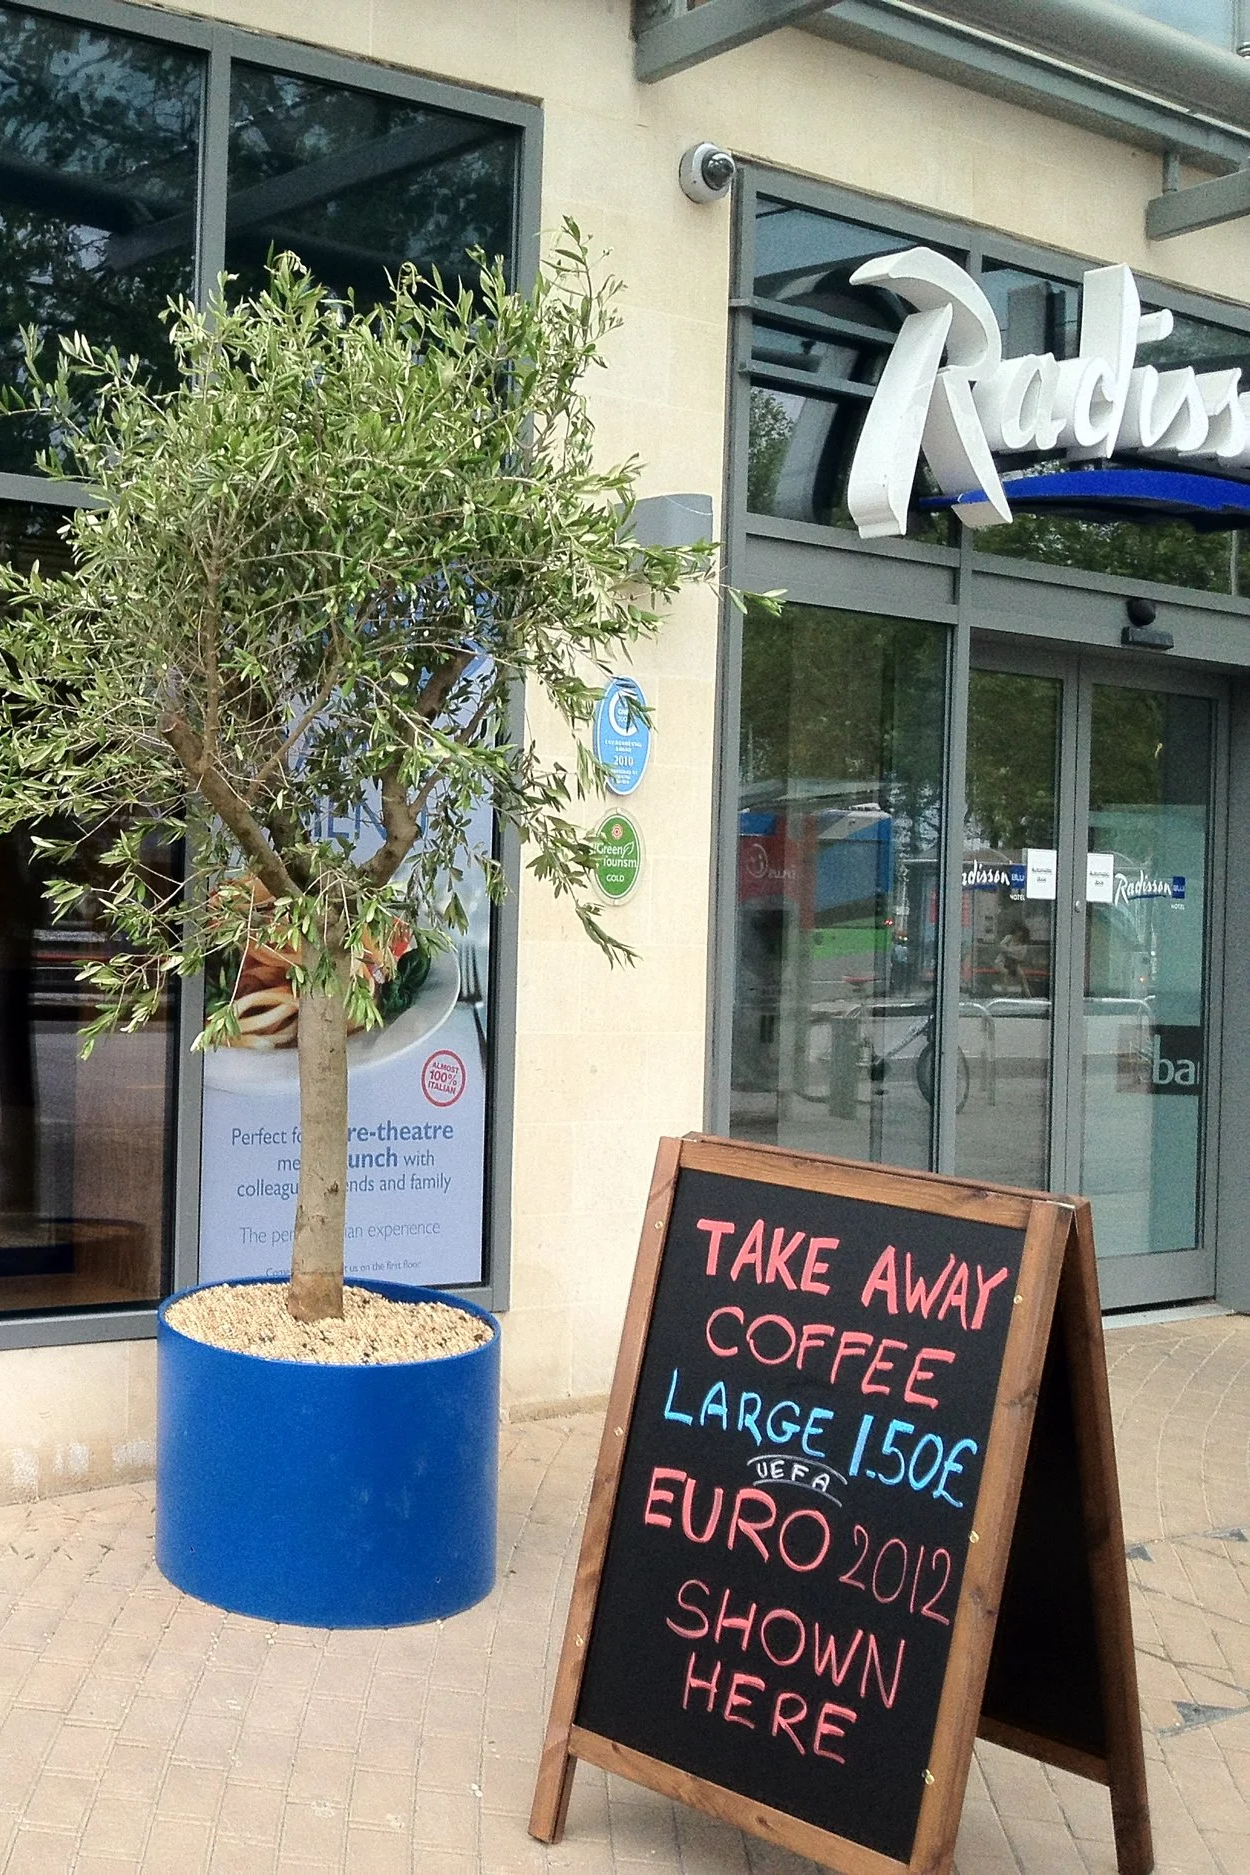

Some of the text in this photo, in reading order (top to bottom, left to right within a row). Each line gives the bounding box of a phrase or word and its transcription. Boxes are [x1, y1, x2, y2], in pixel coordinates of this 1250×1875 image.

[613, 755, 634, 767] 2010
[596, 842, 623, 855] Green
[603, 857, 637, 868] Tourism
[606, 874, 625, 882] GOLD
[1114, 869, 1172, 906] Radisson
[432, 1062, 459, 1074] ALMOST
[1152, 1033, 1200, 1085] ba
[428, 1081, 456, 1094] ITALIAN
[430, 1070, 457, 1086] 100%
[232, 1126, 287, 1146] Perfect
[404, 1149, 435, 1167] with
[380, 1175, 406, 1191] and
[410, 1173, 452, 1194] family
[239, 1226, 267, 1244] The
[367, 1222, 441, 1242] experience
[350, 1264, 359, 1273] us
[360, 1263, 371, 1272] on
[372, 1260, 386, 1271] the
[386, 1259, 402, 1270] first
[402, 1259, 422, 1269] floor
[697, 1218, 1009, 1330] TAKE AWAY
[705, 1306, 956, 1409] COFFEE
[663, 1368, 979, 1508] LARGE 1.50£
[756, 1461, 832, 1492] UEFA
[644, 1467, 952, 1626] EURO 2012
[665, 1579, 905, 1709] SHOWN
[682, 1651, 858, 1764] HERE
